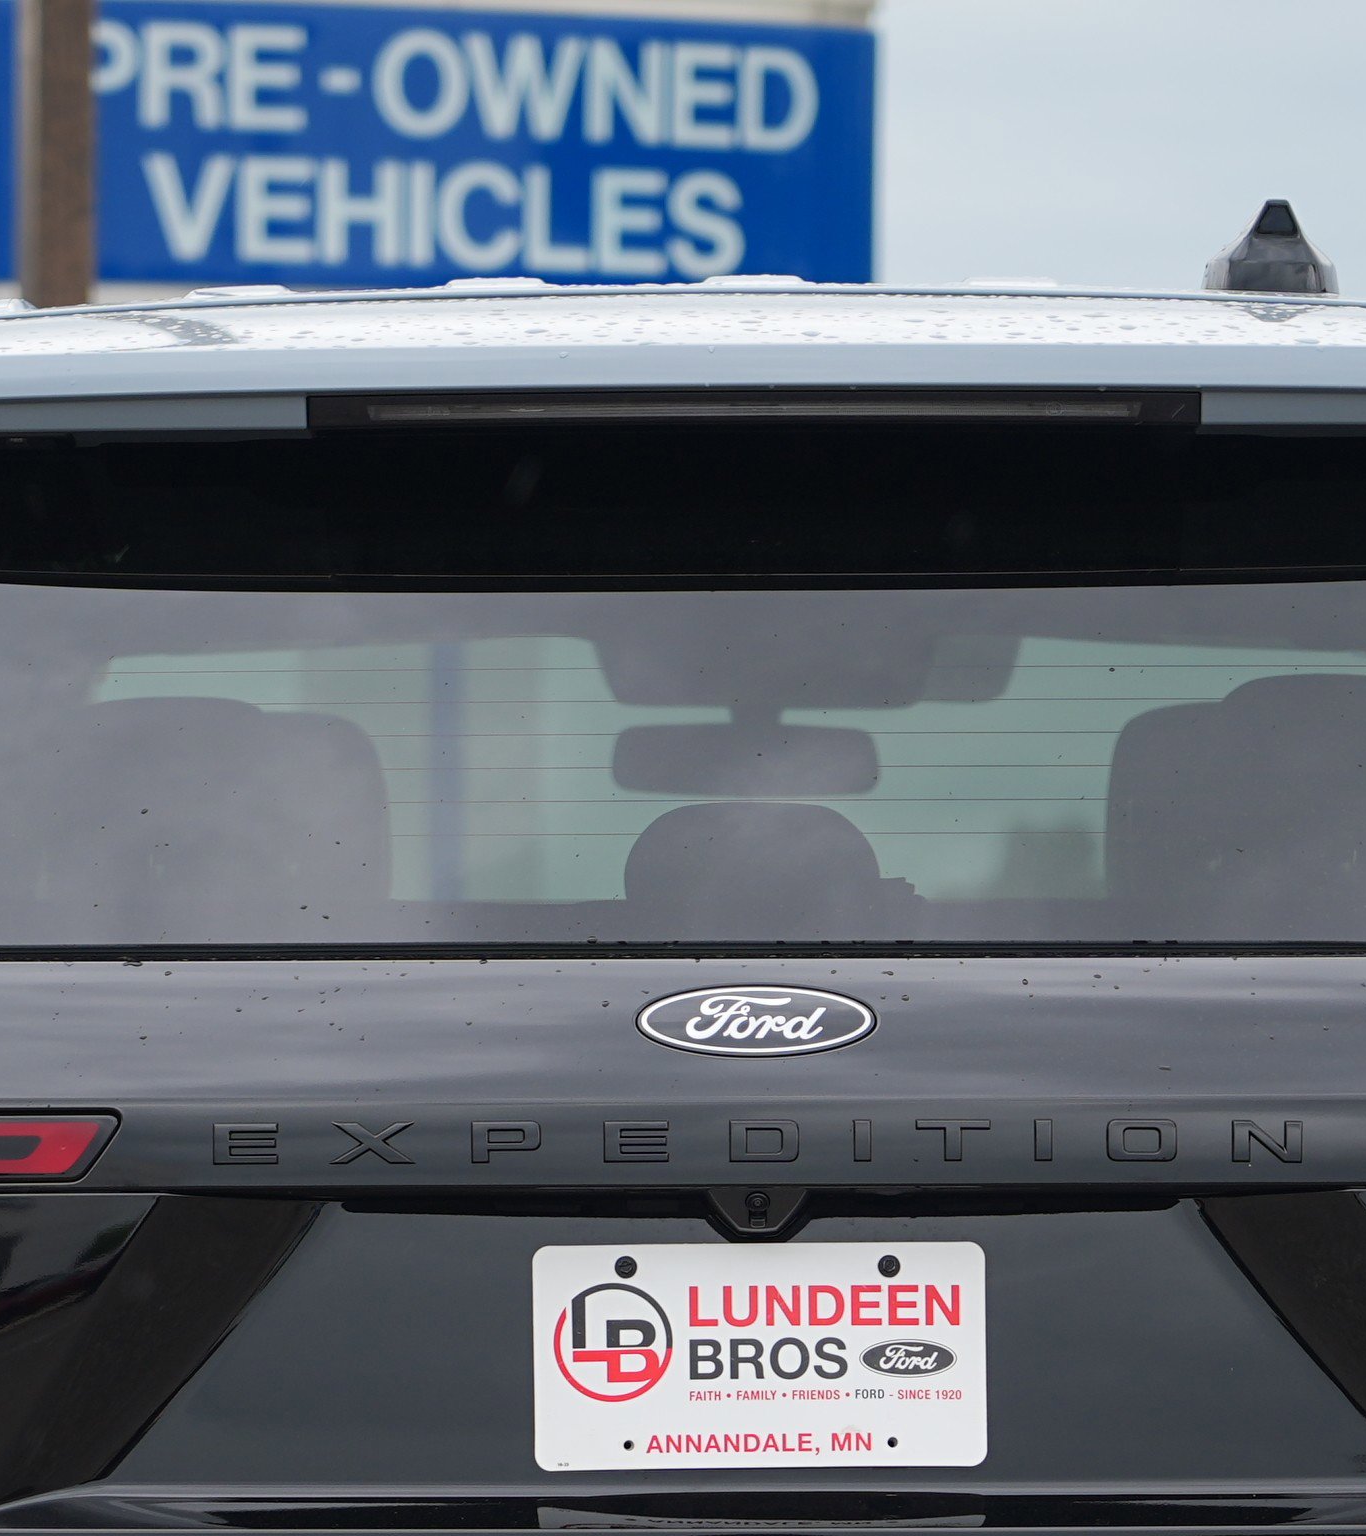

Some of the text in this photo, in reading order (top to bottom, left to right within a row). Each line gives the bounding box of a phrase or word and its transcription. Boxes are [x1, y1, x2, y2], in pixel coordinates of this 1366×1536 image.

[143, 152, 745, 277] VEHICLES
[685, 995, 827, 1040] Ford
[212, 1118, 1305, 1165] EXPEDITION
[689, 1284, 961, 1327] LUNDEEN
[689, 1337, 939, 1380] BROS Ford
[689, 1389, 962, 1401] FAITH FAMILY FRIENDS FORD SINCE 1920
[646, 1432, 873, 1455] ANNANDALE, MN
